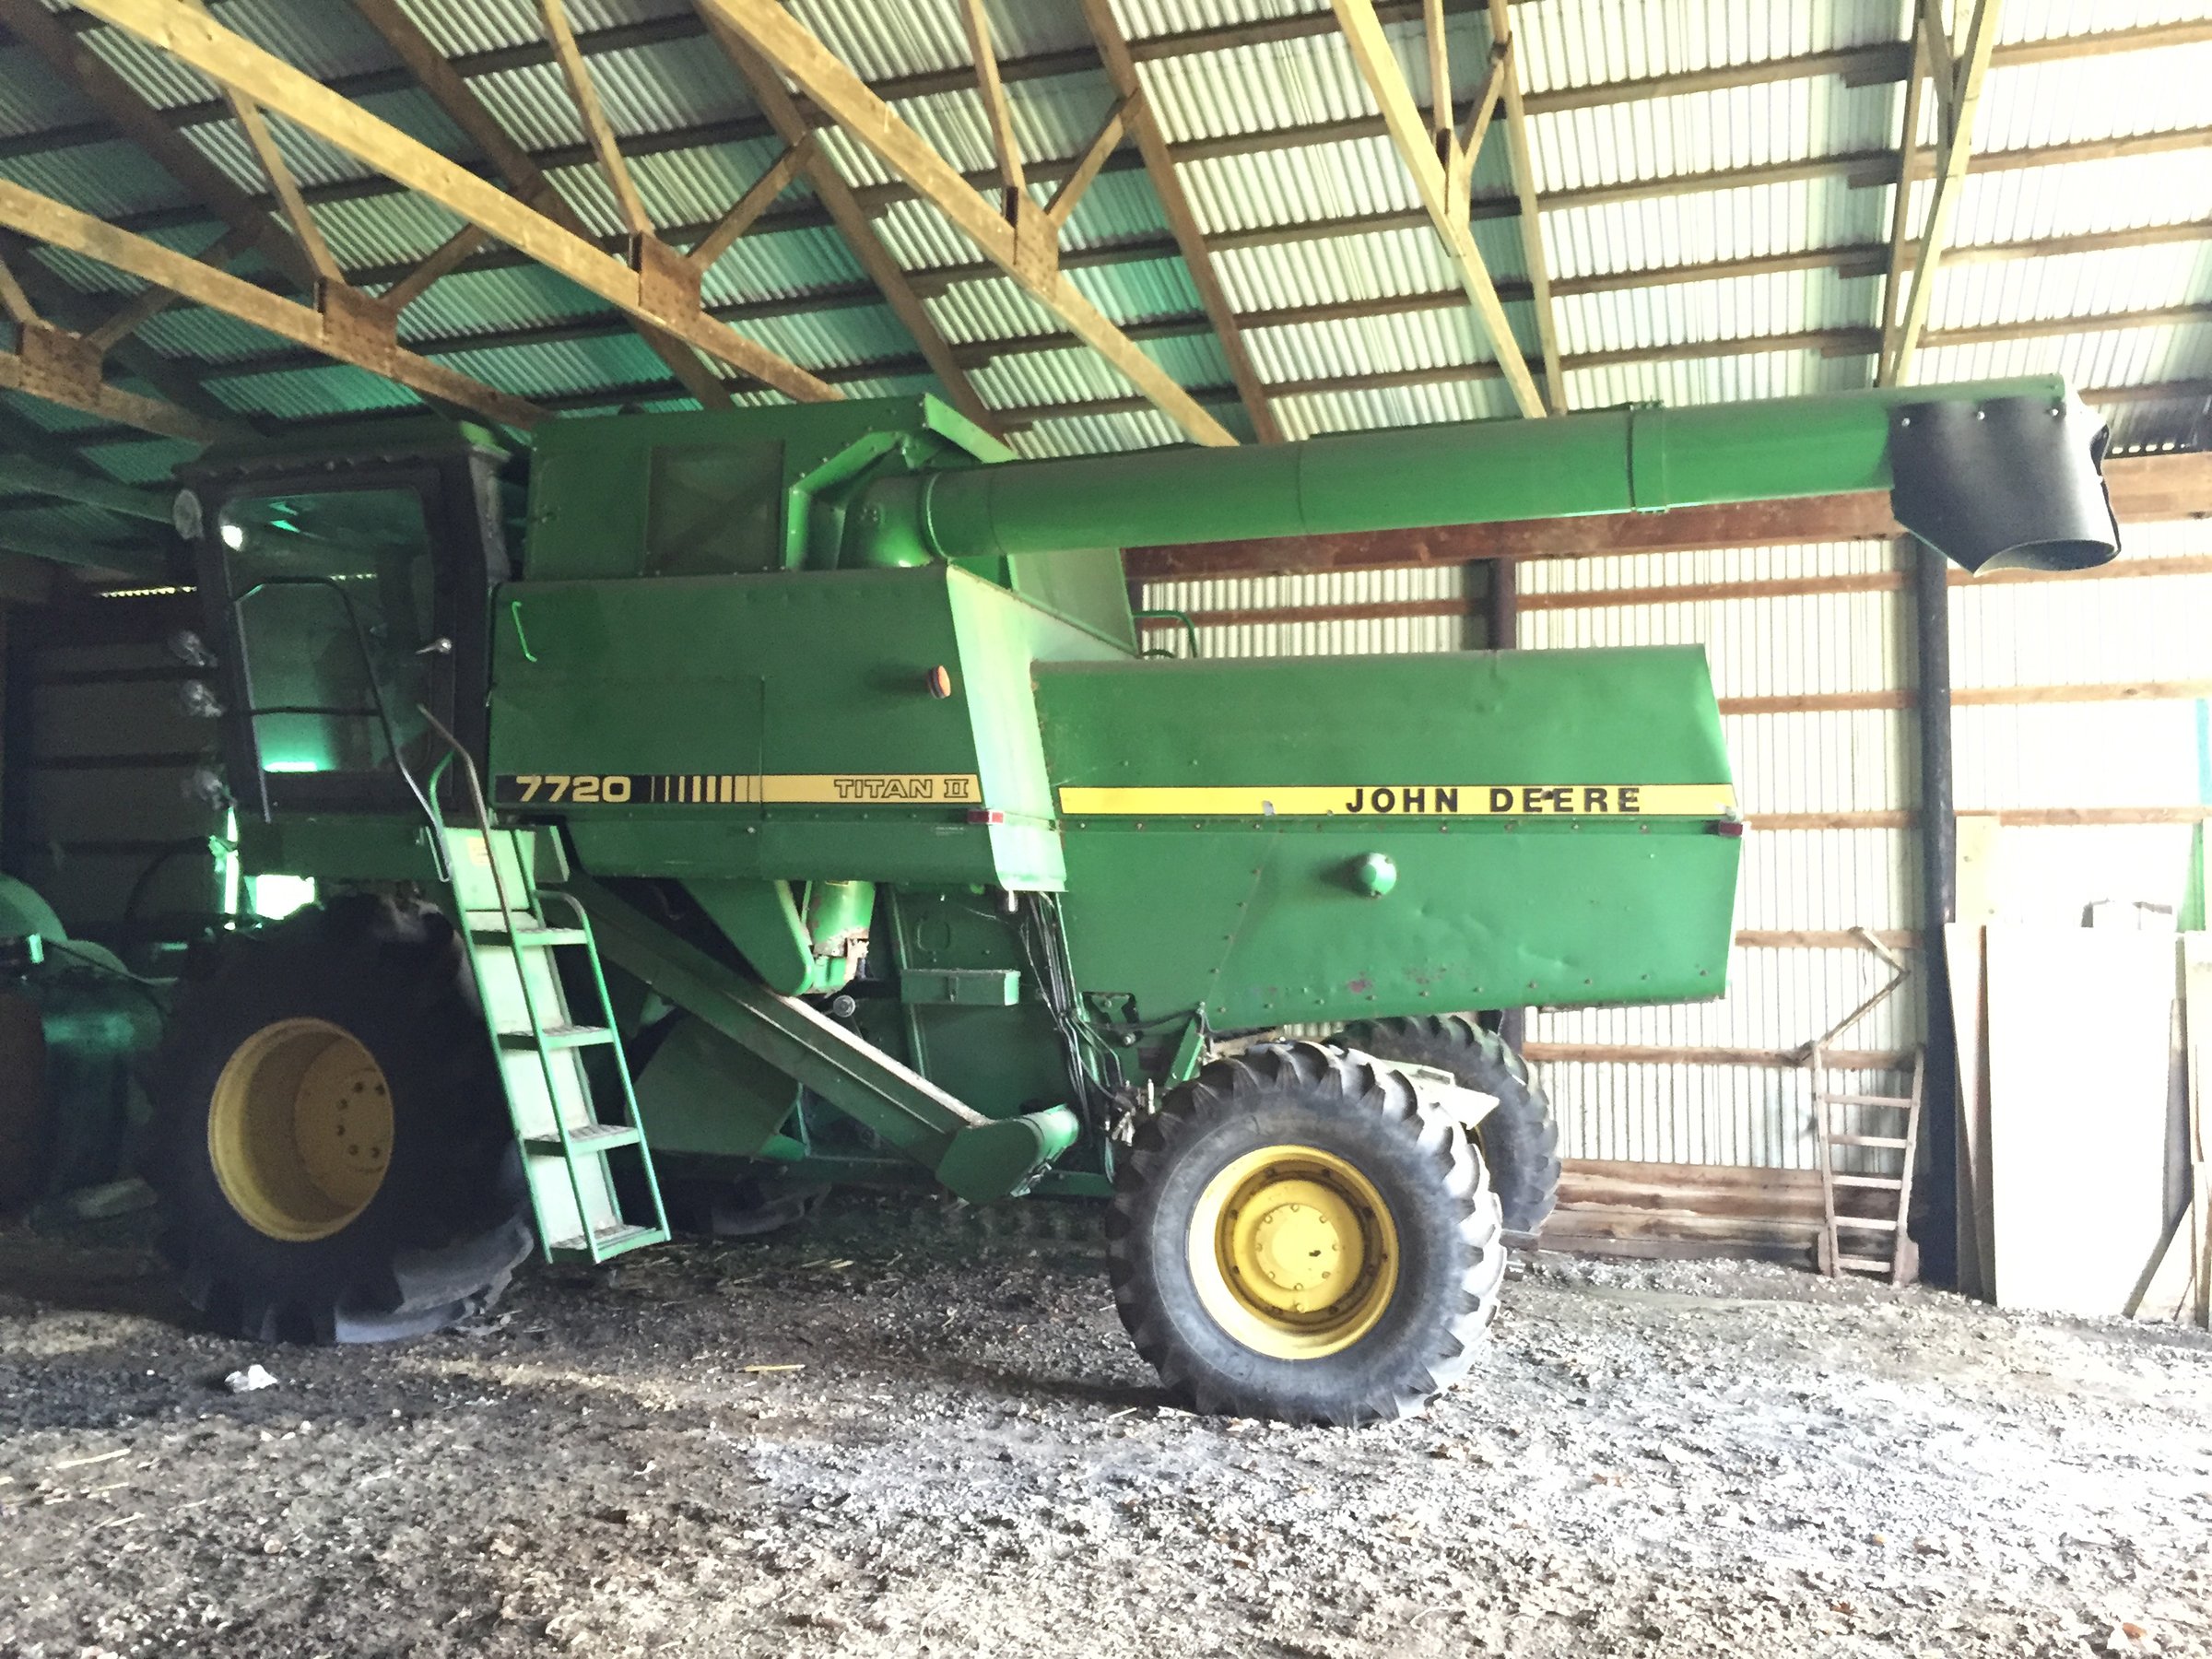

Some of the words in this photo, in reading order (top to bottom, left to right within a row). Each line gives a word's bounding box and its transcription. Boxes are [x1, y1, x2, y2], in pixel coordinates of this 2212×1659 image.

[516, 775, 631, 803] 7720
[834, 779, 933, 798] TITAN
[944, 779, 969, 798] II
[1346, 788, 1458, 813] JOHN
[1489, 787, 1640, 813] DEERE
